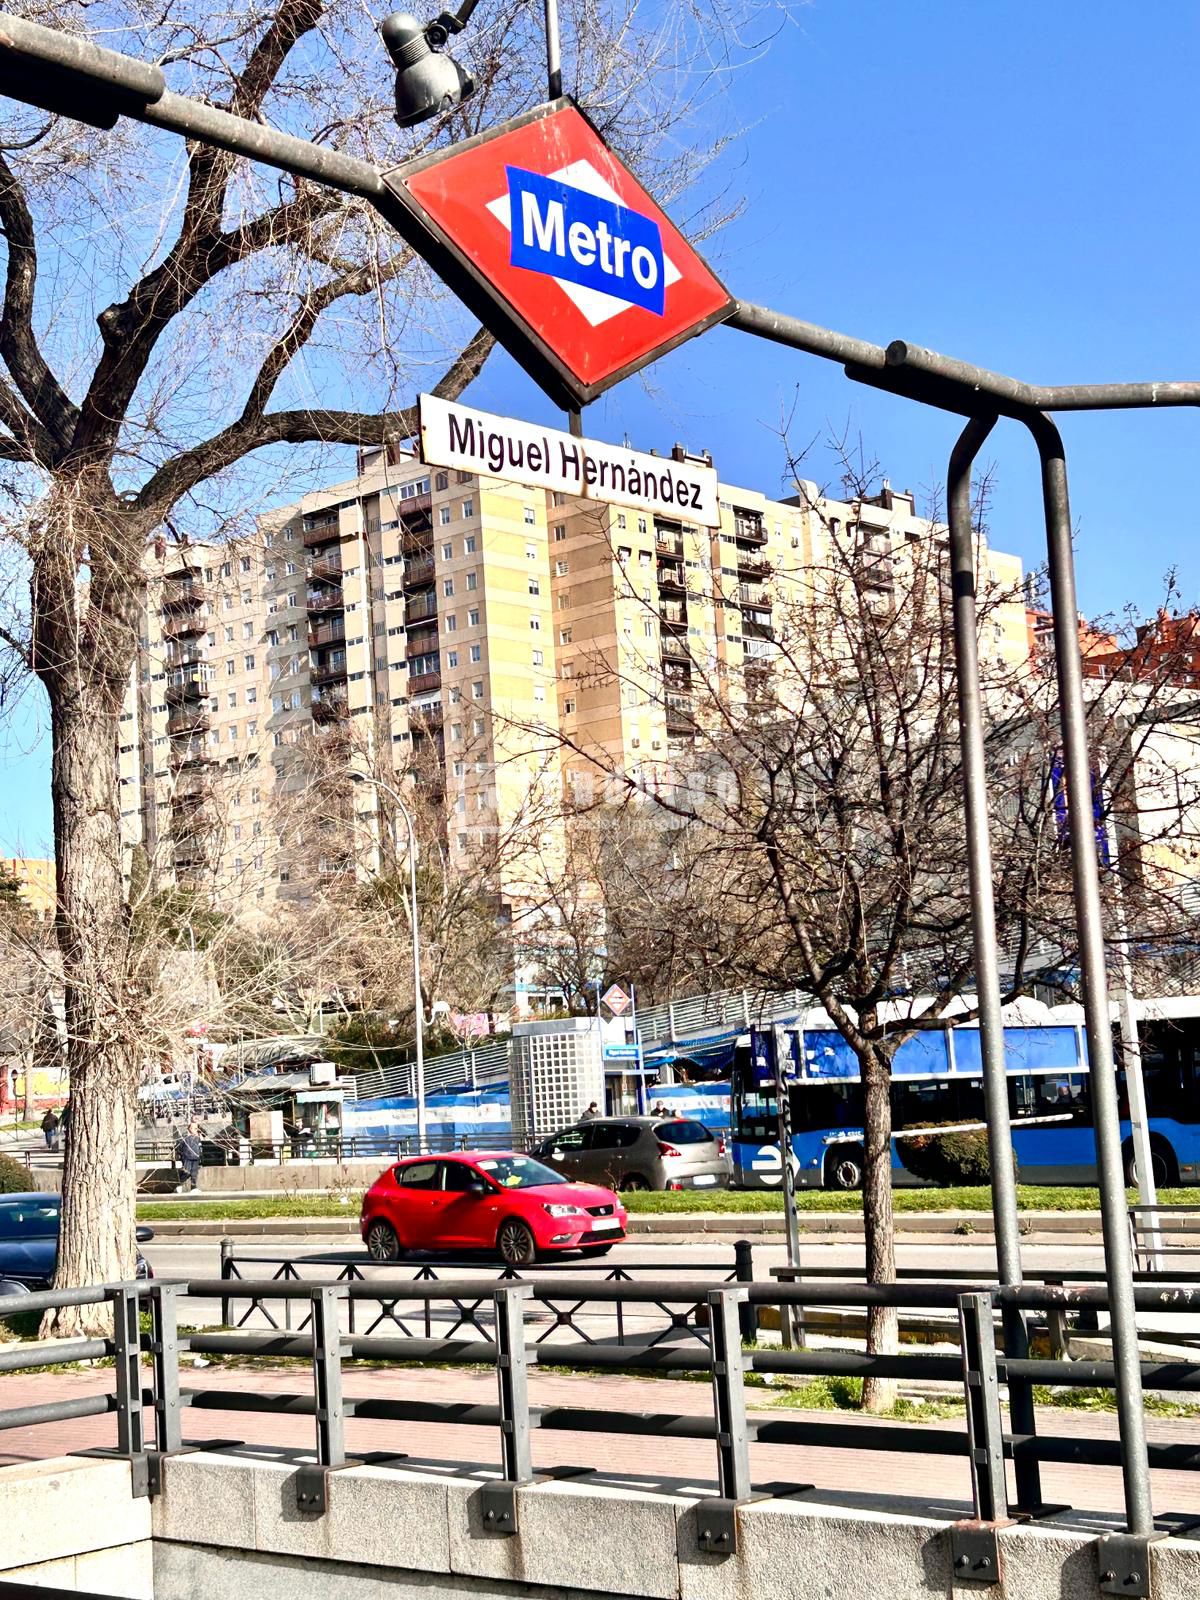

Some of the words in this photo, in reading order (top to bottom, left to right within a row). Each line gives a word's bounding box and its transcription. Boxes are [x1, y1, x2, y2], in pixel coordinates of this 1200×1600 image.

[523, 190, 658, 290] Metro
[448, 413, 550, 474] Miguel
[560, 442, 703, 510] Hernández
